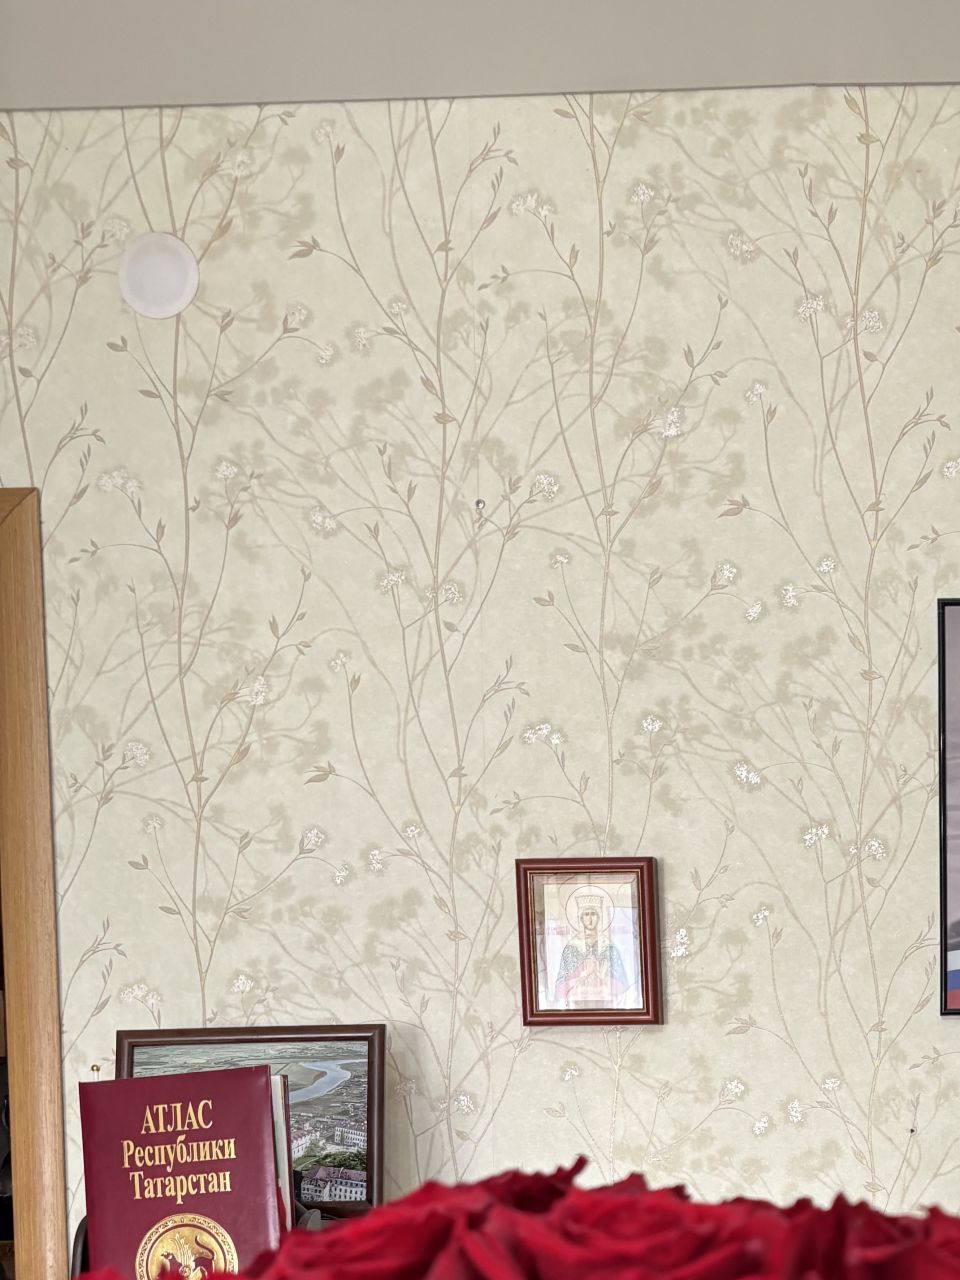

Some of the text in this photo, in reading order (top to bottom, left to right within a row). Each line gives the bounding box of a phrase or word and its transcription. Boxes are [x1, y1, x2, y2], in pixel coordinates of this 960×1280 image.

[140, 1099, 213, 1135] АТЛАС
[121, 1135, 237, 1173] Республики
[129, 1170, 232, 1205] Татарстан
